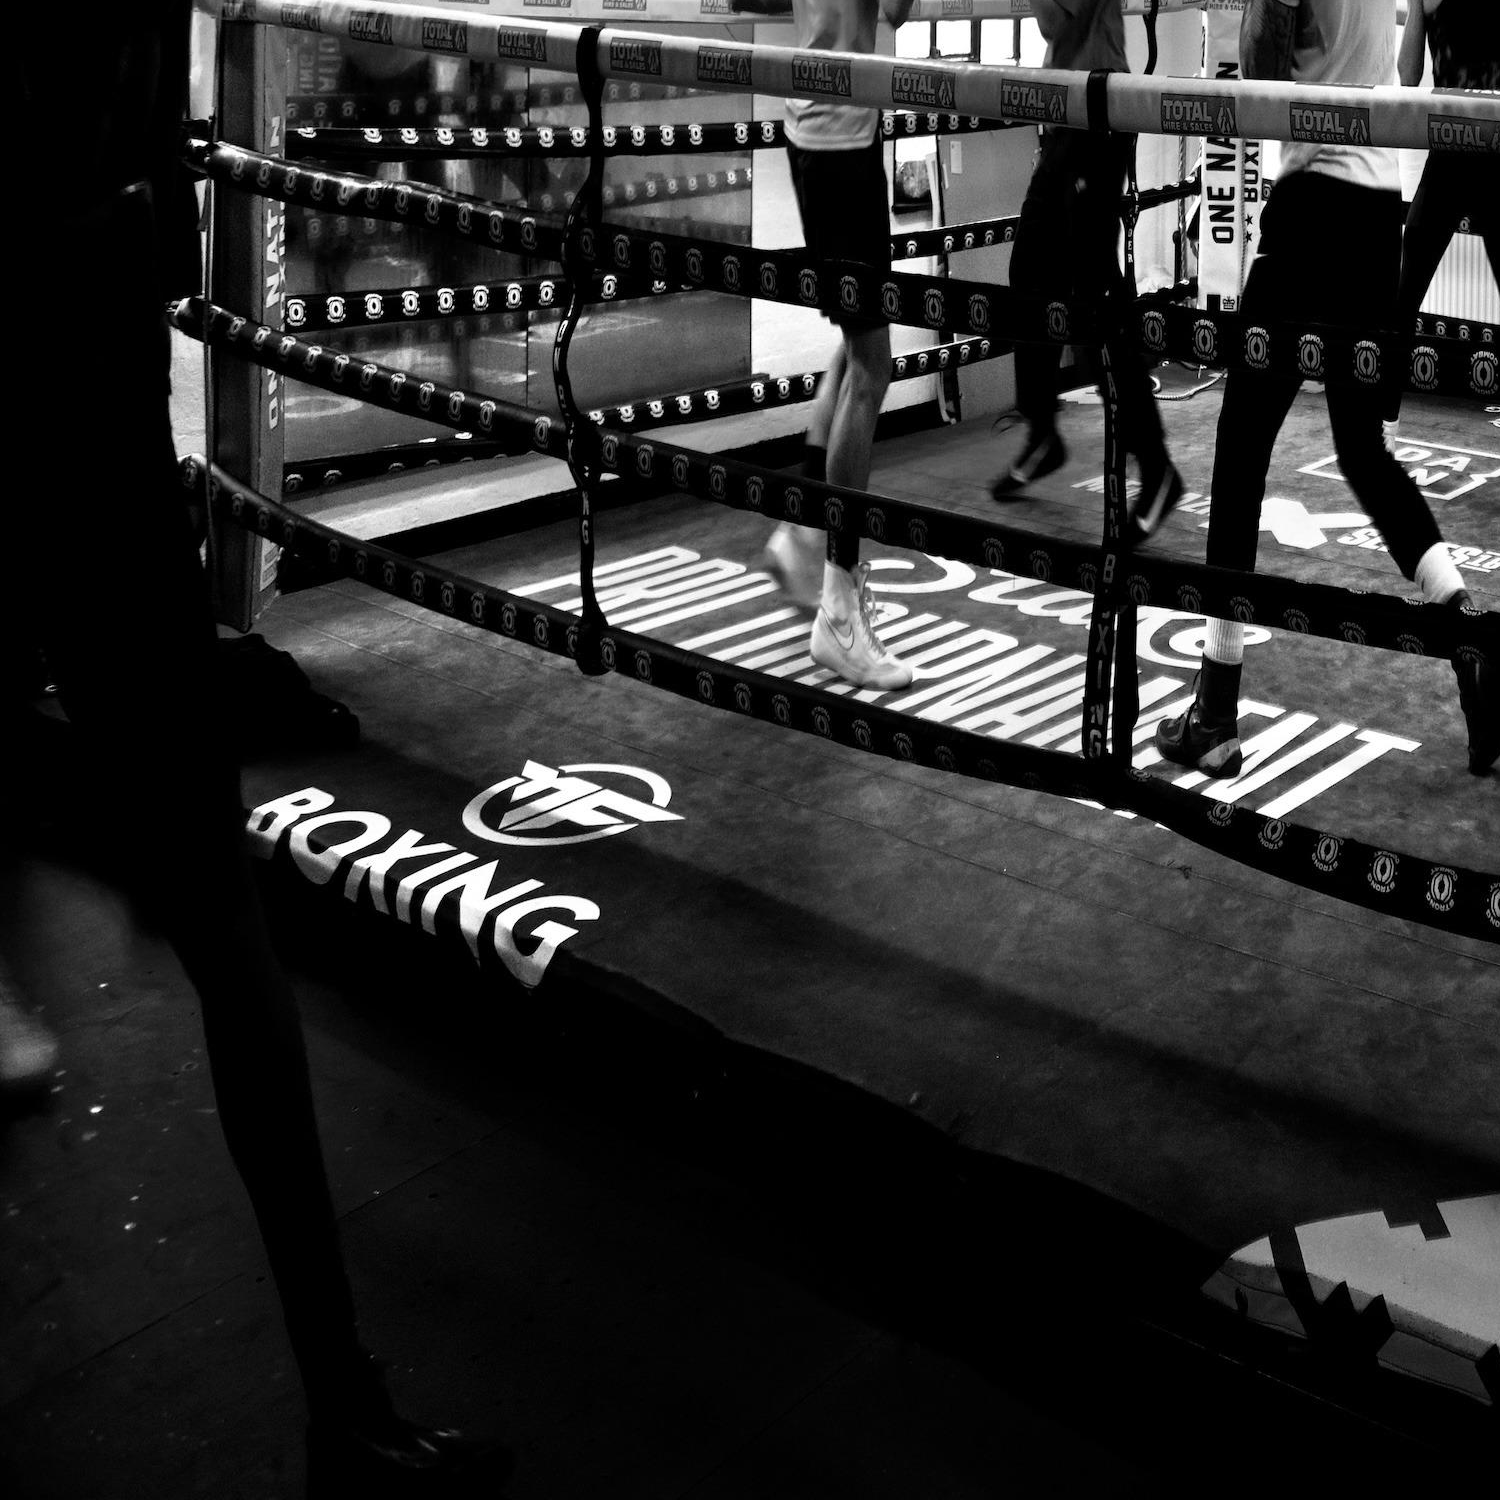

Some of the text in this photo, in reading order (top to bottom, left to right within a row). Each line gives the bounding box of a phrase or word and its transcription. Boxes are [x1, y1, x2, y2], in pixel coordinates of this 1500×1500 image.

[351, 14, 379, 36] TOTAL
[423, 21, 453, 41] TOTAL
[501, 29, 533, 50] TOTAL
[611, 42, 644, 61] TOTAL
[699, 51, 734, 72] TOTAL
[793, 59, 832, 80] TOTAL
[893, 71, 935, 94] TOTAL
[1002, 83, 1046, 108] TOTAL
[1163, 100, 1213, 122] TOTAL
[1291, 109, 1344, 134] TOTAL
[1163, 120, 1182, 131] HIRE
[1190, 122, 1214, 133] SALES
[1293, 130, 1312, 140] HIRE
[1321, 132, 1347, 143] SALES
[1430, 121, 1486, 148] TOTAL
[1207, 186, 1235, 244] ONE
[245, 786, 601, 990] BOXING
[1426, 891, 1456, 912] STRONG
